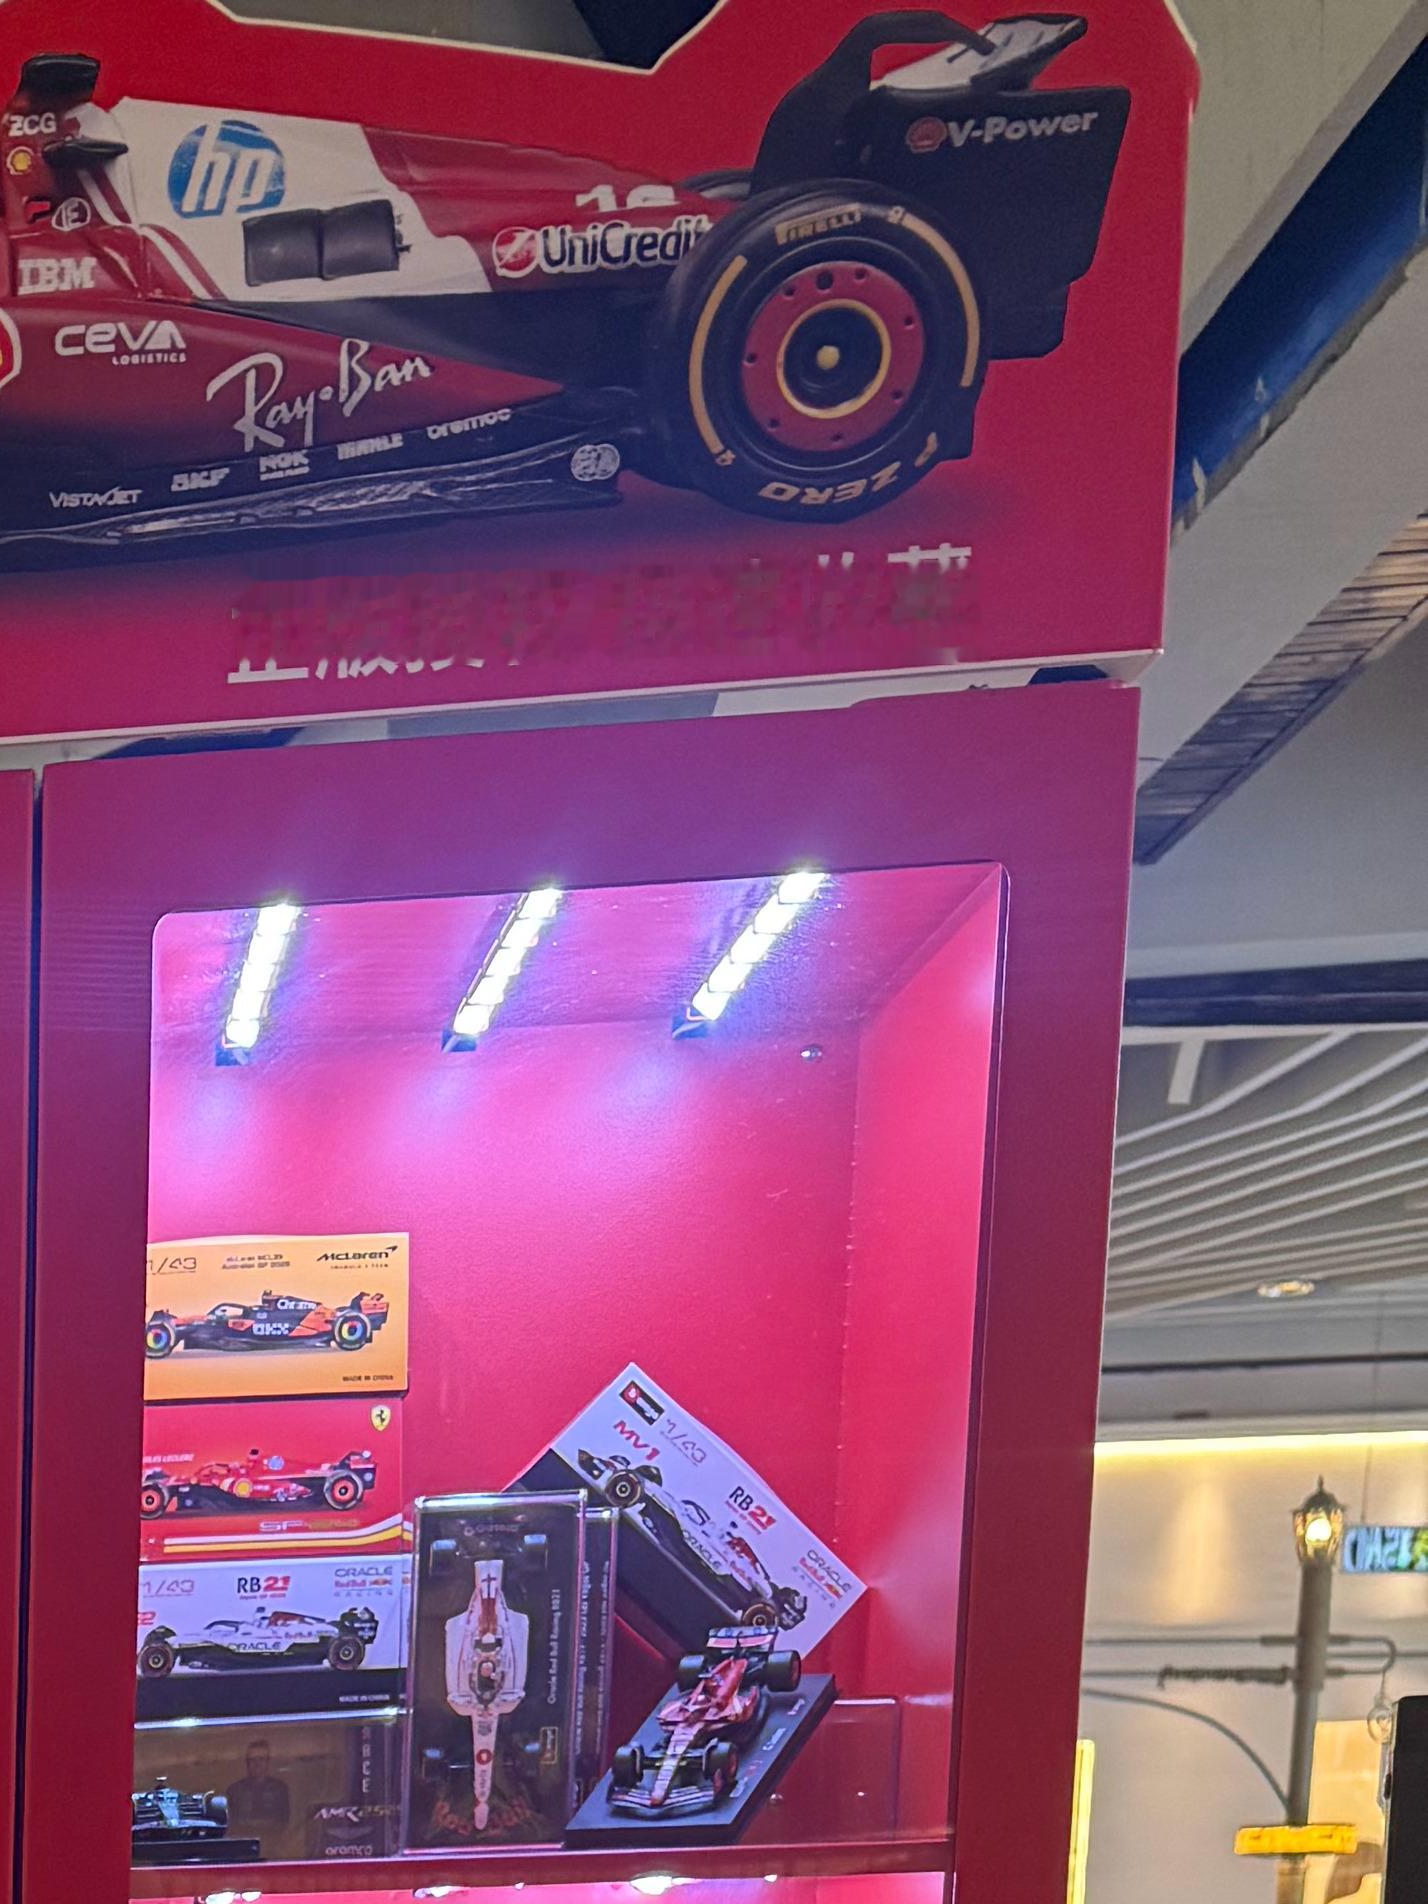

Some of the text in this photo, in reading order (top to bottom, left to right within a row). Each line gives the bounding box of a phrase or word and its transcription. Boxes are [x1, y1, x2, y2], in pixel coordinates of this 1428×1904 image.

[946, 108, 1099, 149] V-Power
[174, 119, 282, 218] hp
[18, 257, 98, 292] IBM
[316, 1252, 389, 1261] McLaren
[728, 1485, 777, 1531] RB21
[236, 1575, 291, 1593] RB21
[334, 1567, 393, 1577] ORACLE
[806, 1548, 853, 1593] ORACLE
[227, 1642, 281, 1652] ORACLE
